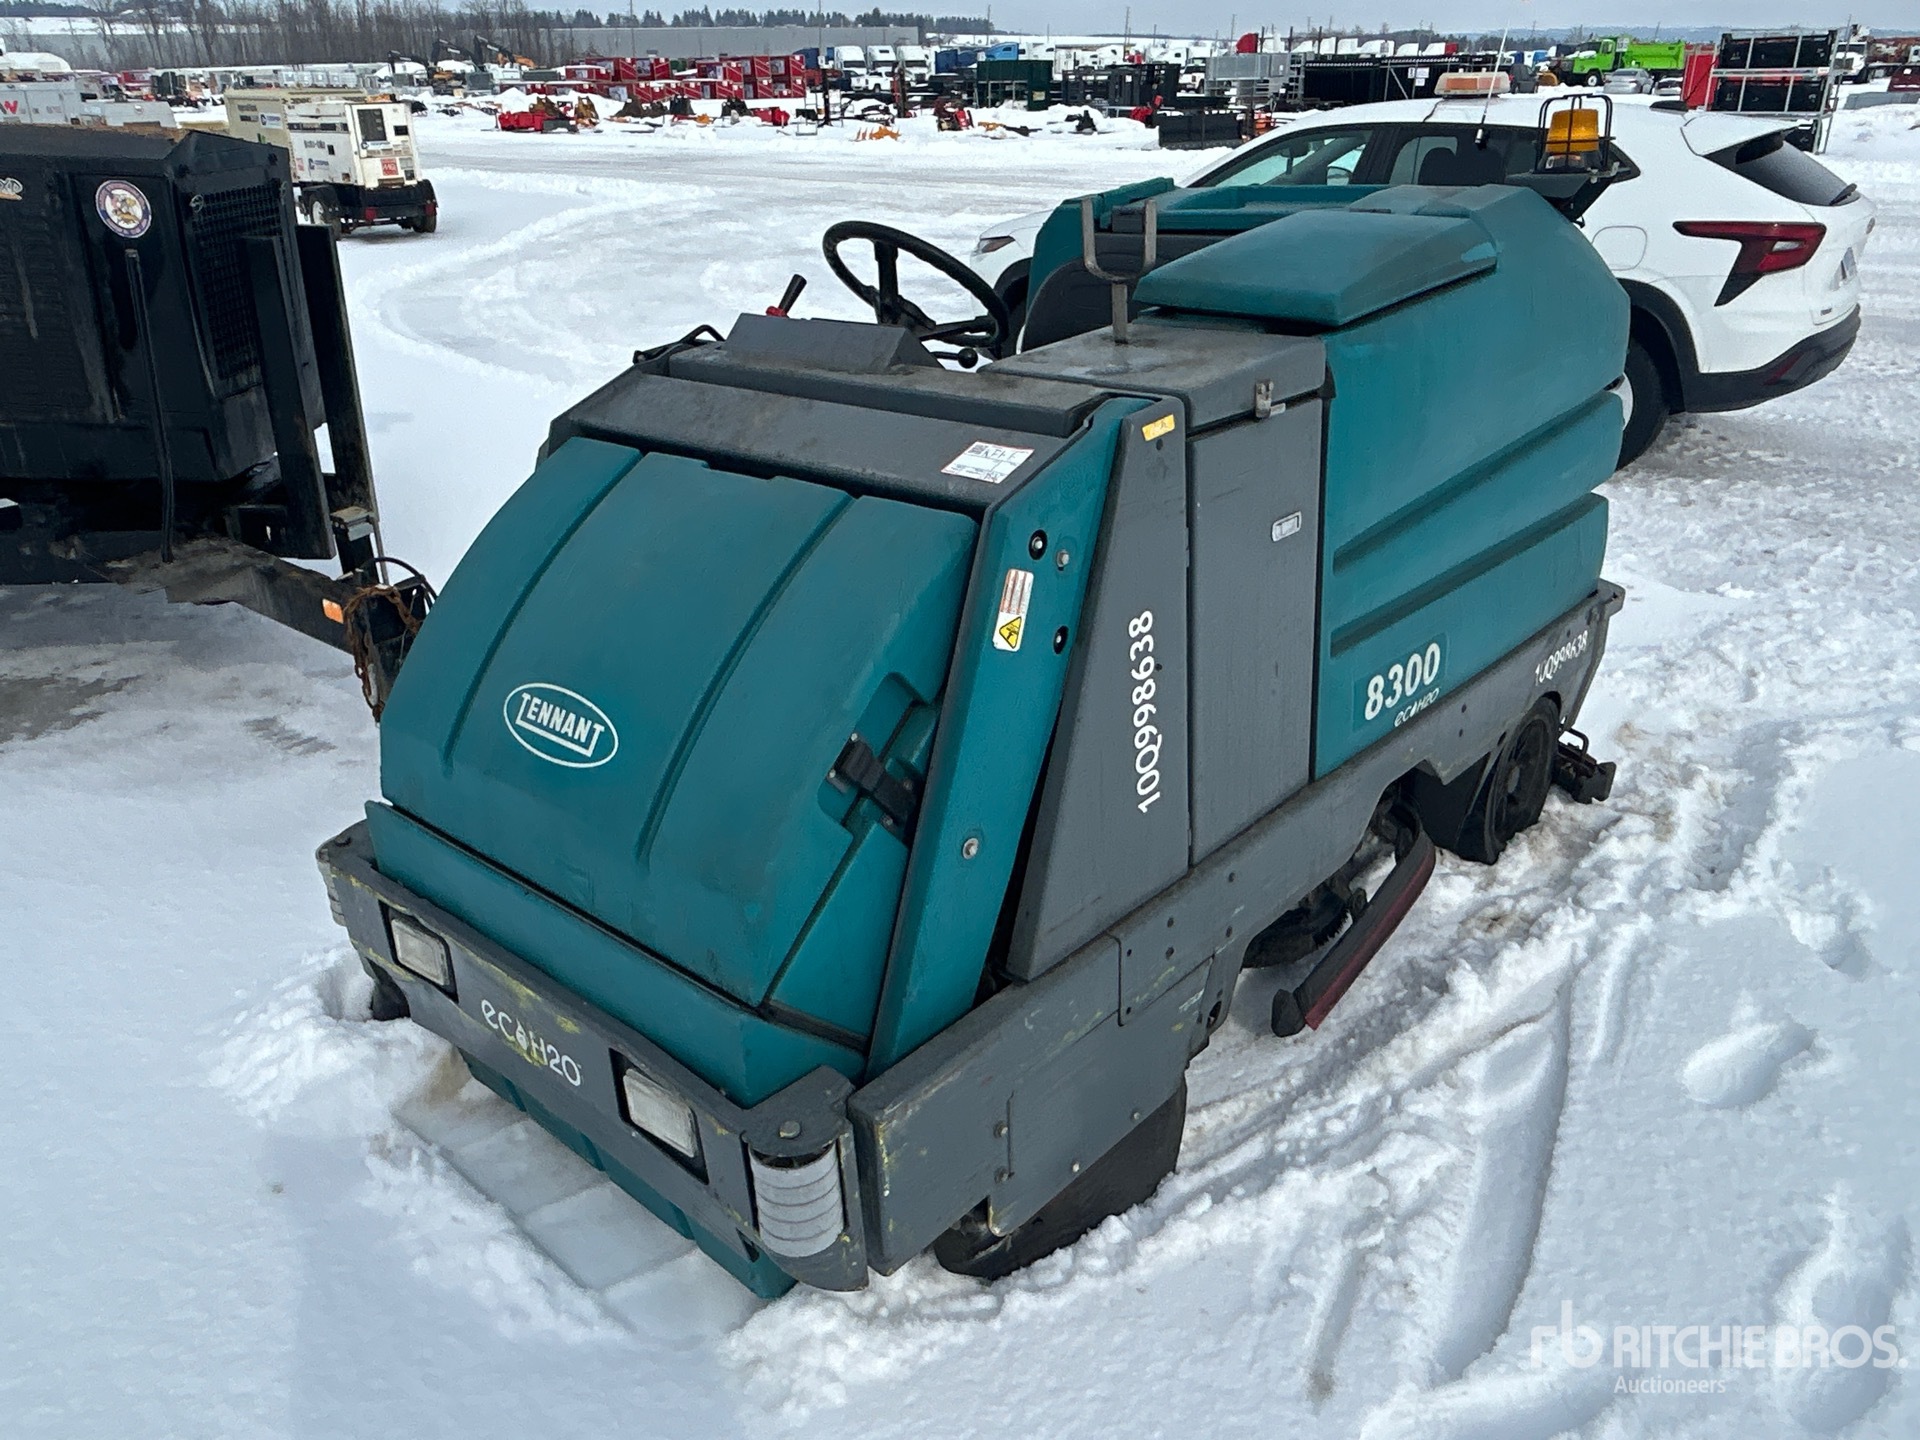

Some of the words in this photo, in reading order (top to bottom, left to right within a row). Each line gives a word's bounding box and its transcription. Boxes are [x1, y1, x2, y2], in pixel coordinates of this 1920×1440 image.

[1128, 610, 1162, 813] 10Q998638
[1365, 642, 1441, 721] 8300
[515, 692, 605, 757] TENNANT
